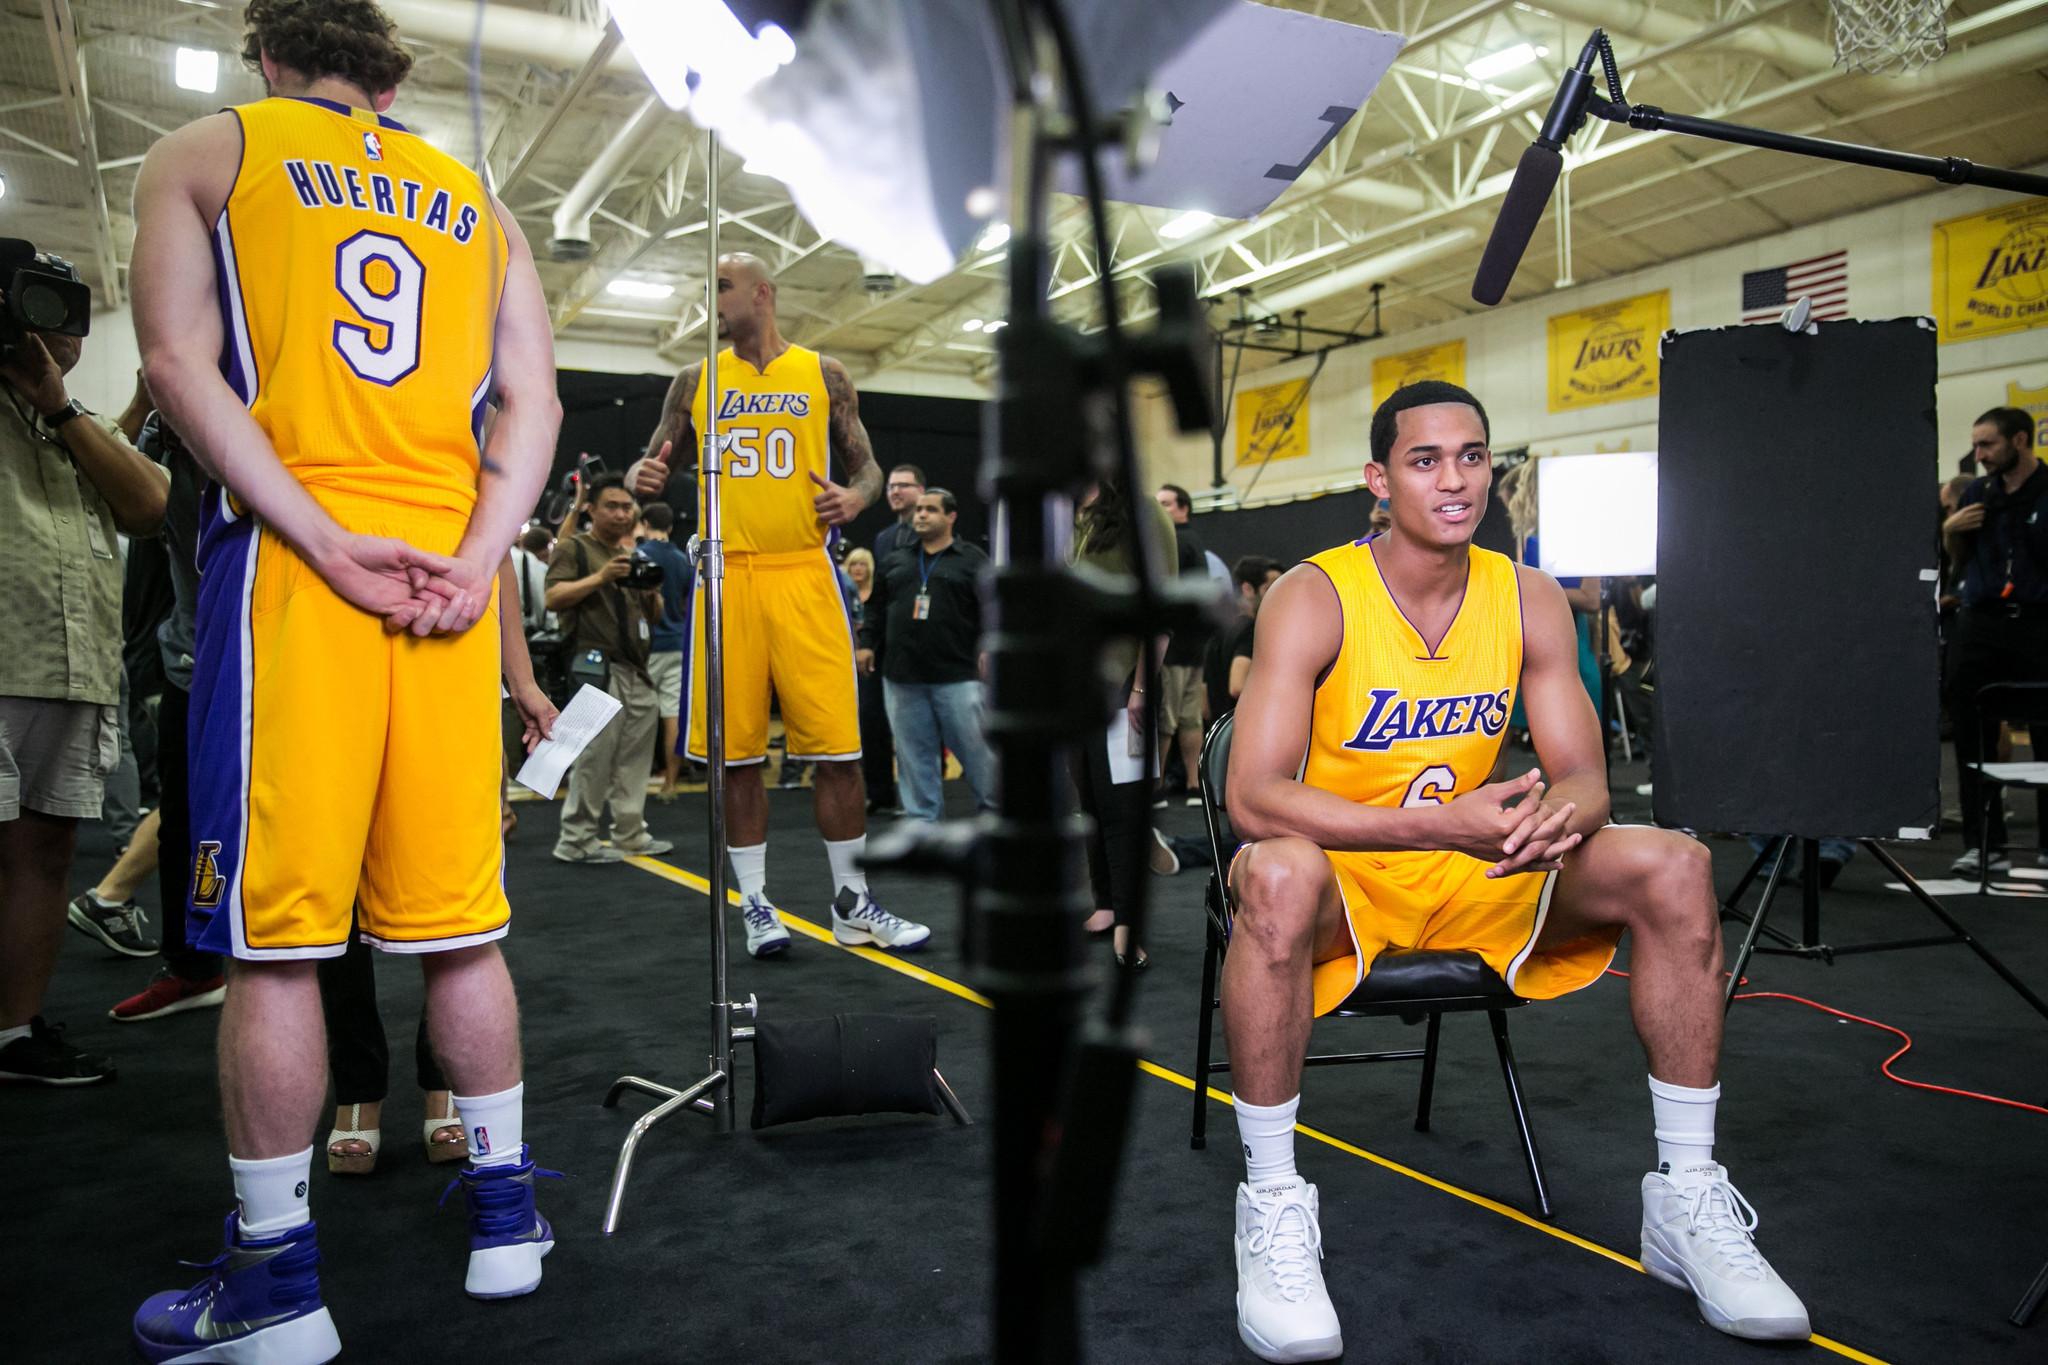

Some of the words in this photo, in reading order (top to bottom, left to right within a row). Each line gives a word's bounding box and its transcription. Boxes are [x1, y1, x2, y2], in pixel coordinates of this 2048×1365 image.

[283, 158, 480, 245] HUERTAS
[333, 228, 427, 388] 9
[1967, 299, 2013, 319] WORLD
[717, 388, 810, 421] LAKERS
[729, 427, 796, 479] 50
[1341, 687, 1511, 752] LAKERS
